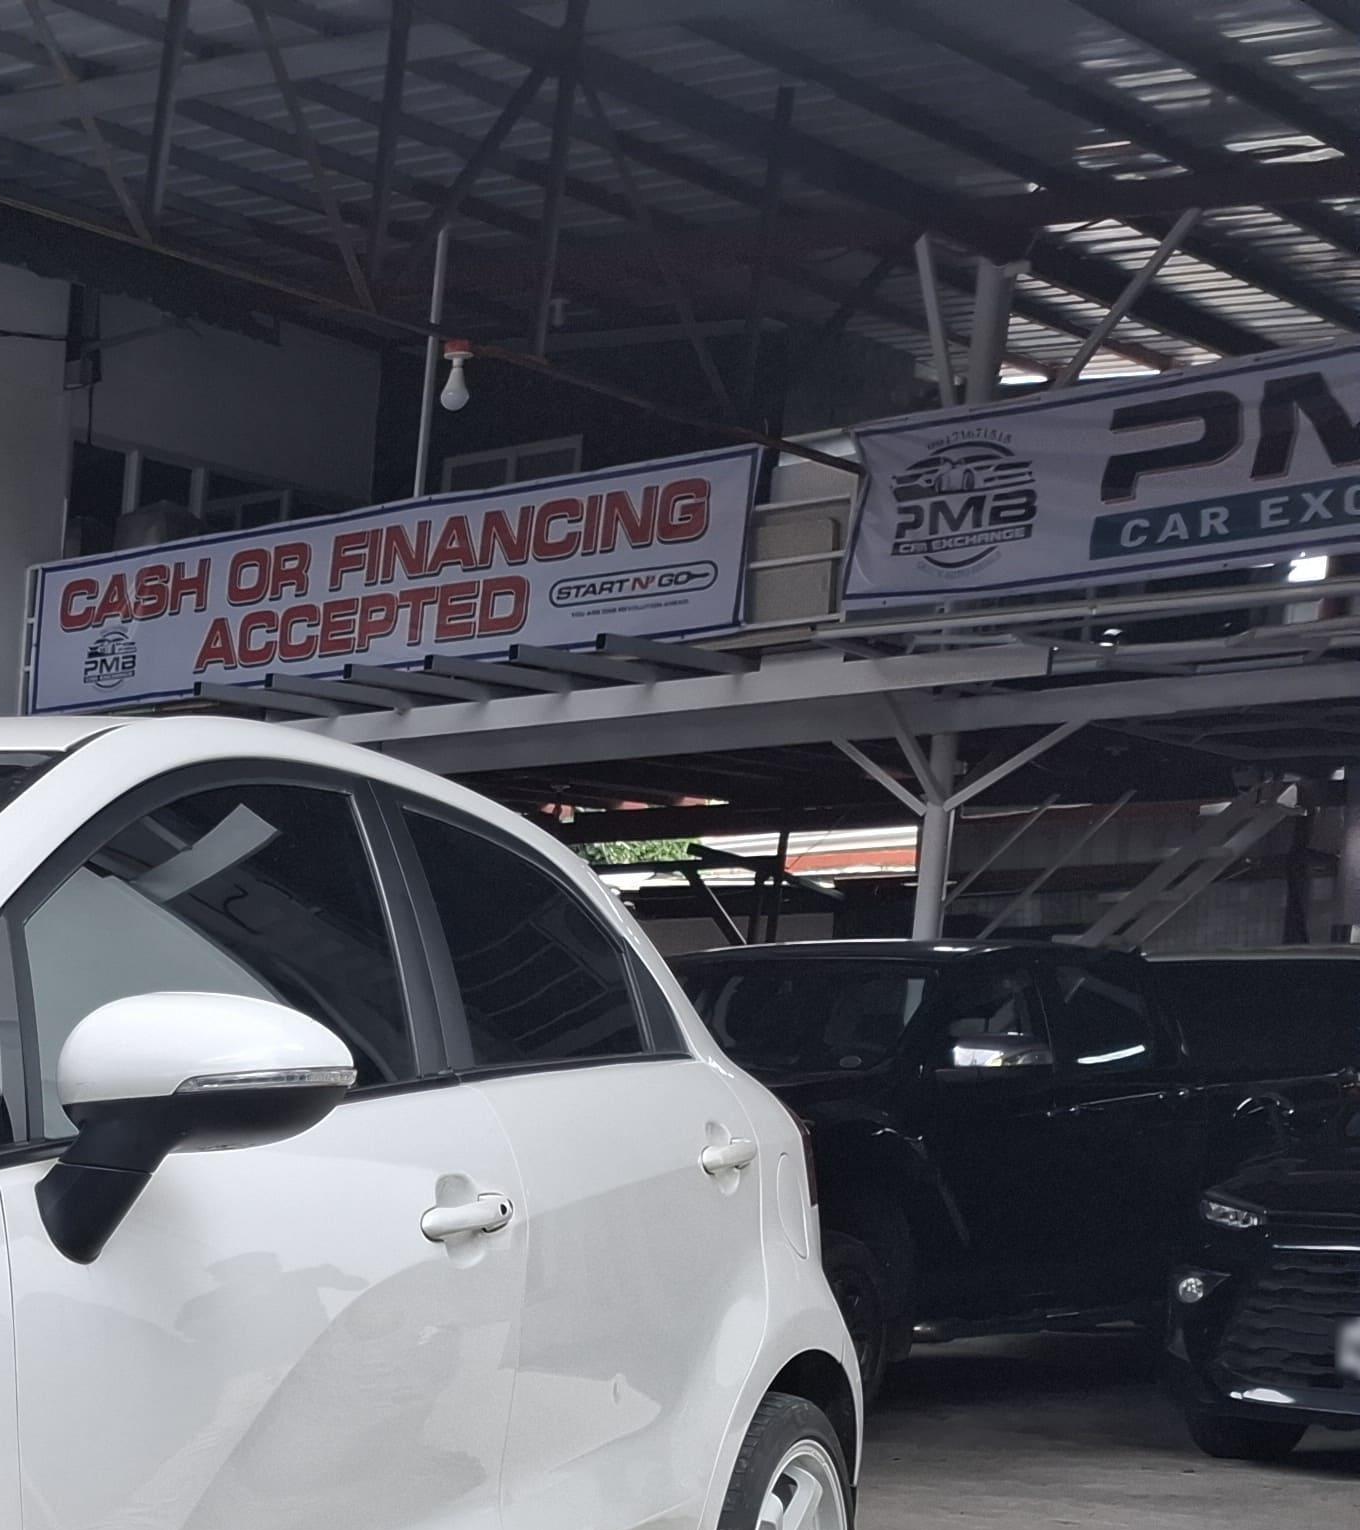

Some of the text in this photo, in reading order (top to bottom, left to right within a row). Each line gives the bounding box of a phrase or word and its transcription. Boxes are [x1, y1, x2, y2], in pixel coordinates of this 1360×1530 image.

[894, 488, 1039, 541] PMB
[1119, 505, 1230, 549] CAR
[58, 476, 713, 635] CASH OR FINANCING
[931, 526, 1027, 551] EXCHANGE
[556, 578, 630, 601] START
[192, 574, 532, 675] ACCEPTED
[84, 654, 137, 676] PMB
